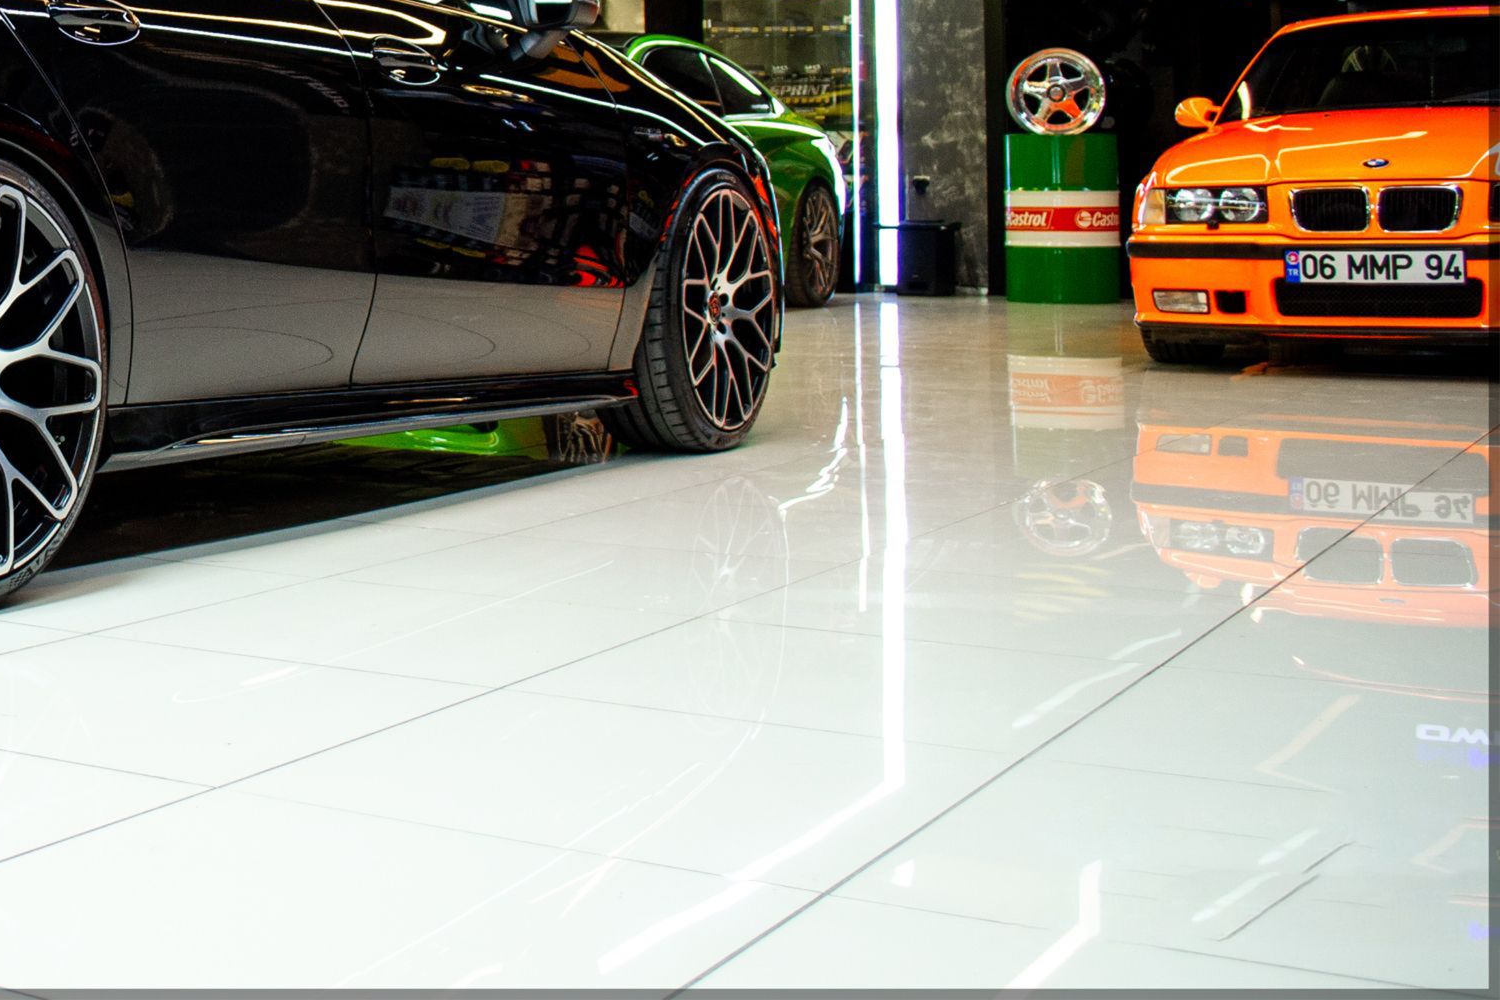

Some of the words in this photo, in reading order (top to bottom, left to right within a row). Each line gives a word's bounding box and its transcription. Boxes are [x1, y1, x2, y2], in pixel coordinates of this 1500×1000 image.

[1287, 268, 1299, 277] TR
[1302, 254, 1336, 280] 06
[1347, 254, 1413, 280] MMP
[1425, 254, 1462, 280] 94
